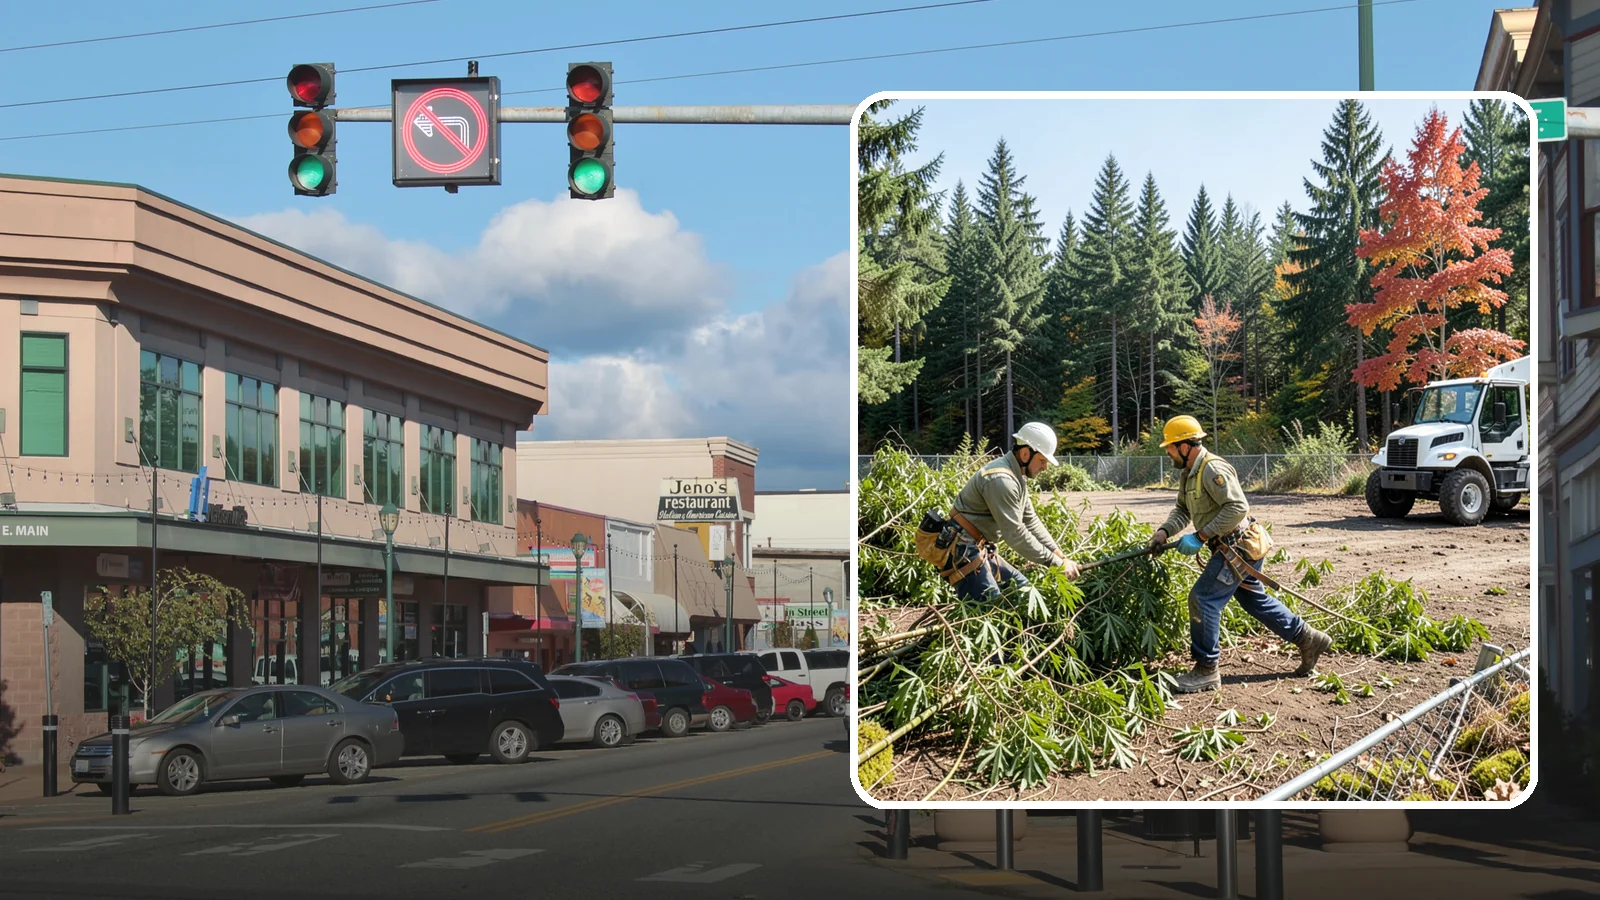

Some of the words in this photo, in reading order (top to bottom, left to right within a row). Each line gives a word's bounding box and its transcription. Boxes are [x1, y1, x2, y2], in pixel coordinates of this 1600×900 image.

[670, 480, 727, 494] Jeno's
[665, 496, 731, 509] restaurant
[715, 510, 737, 519] Cuisine
[2, 525, 13, 536] E.
[15, 525, 49, 536] MAIN
[797, 607, 828, 616] Street
